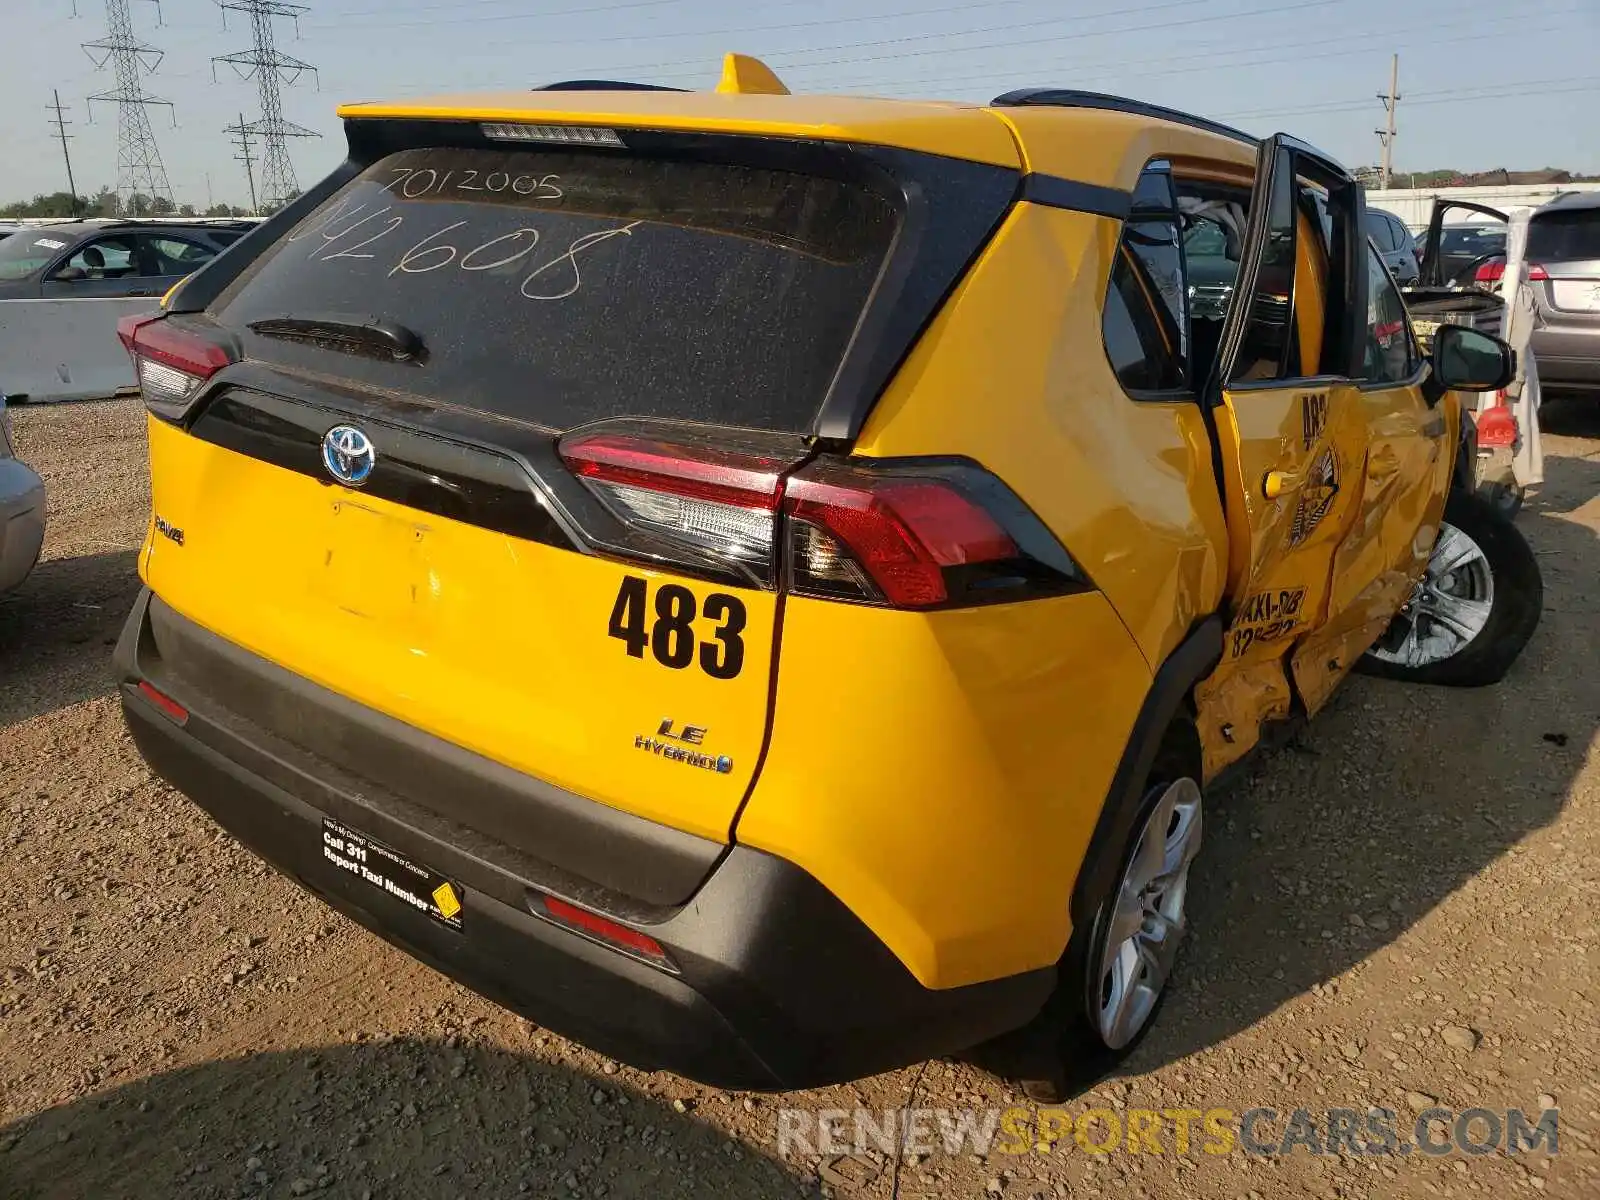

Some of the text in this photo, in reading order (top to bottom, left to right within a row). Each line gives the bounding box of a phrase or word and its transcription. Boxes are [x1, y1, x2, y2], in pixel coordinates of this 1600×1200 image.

[608, 575, 747, 680] 483
[657, 717, 708, 745] LE
[634, 735, 718, 771] HYBRID
[323, 832, 367, 862] Call 311
[323, 846, 428, 911] Report Taxi Number
